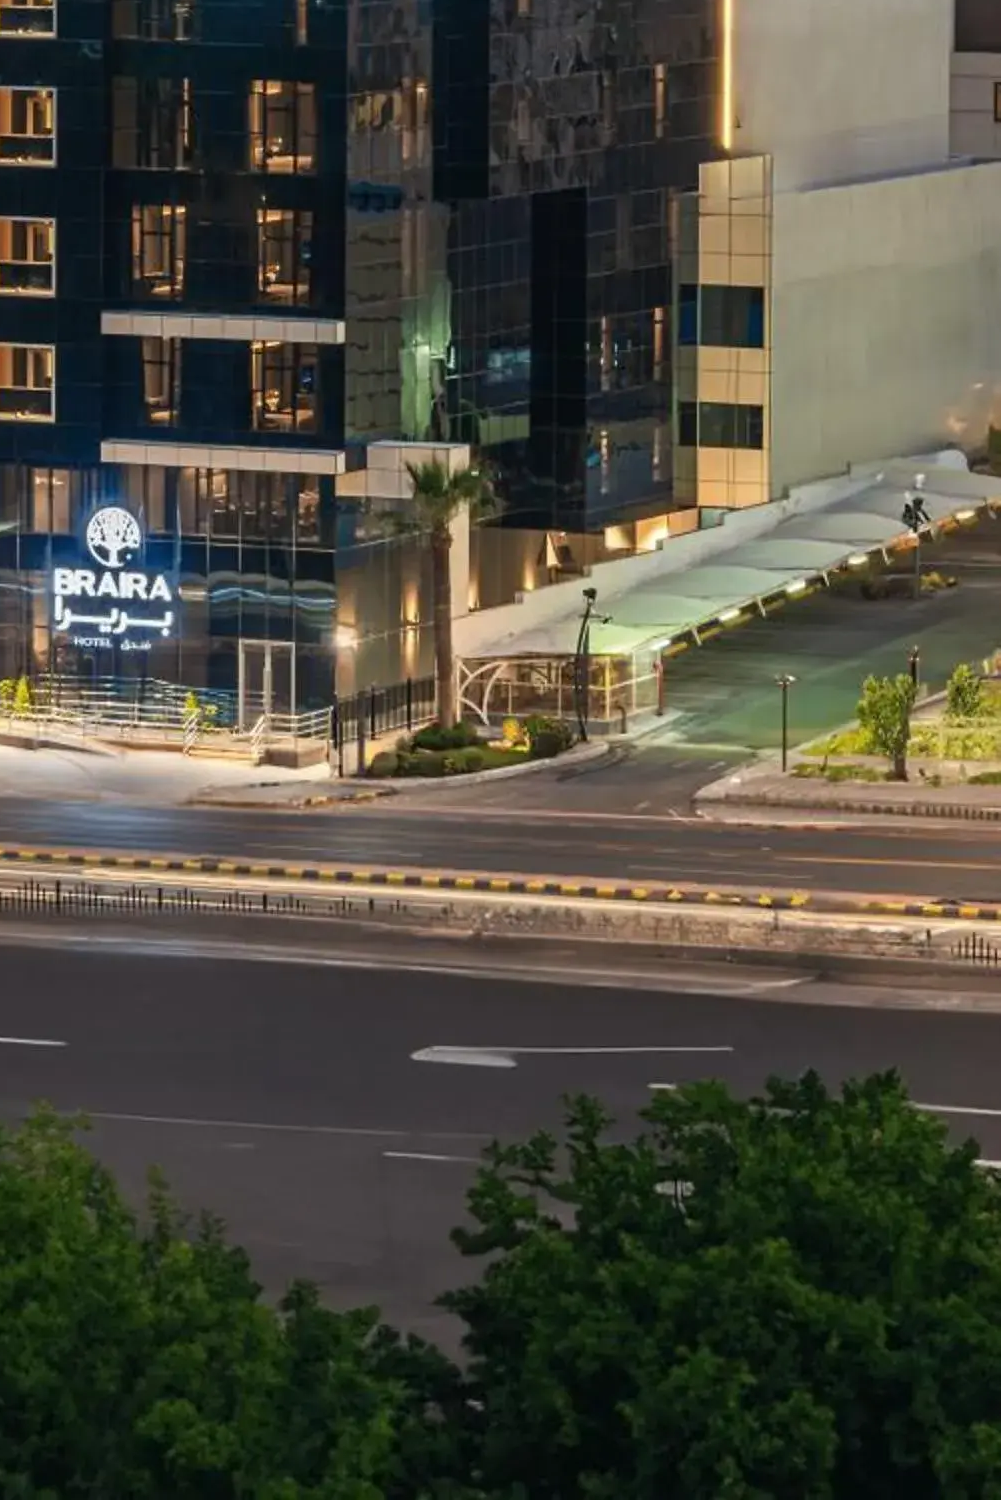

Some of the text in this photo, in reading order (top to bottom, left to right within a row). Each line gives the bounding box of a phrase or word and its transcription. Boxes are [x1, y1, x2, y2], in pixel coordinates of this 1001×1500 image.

[52, 567, 173, 602] BRAIRA
[53, 594, 174, 637] بريرا
[73, 635, 114, 649] HOTEL
